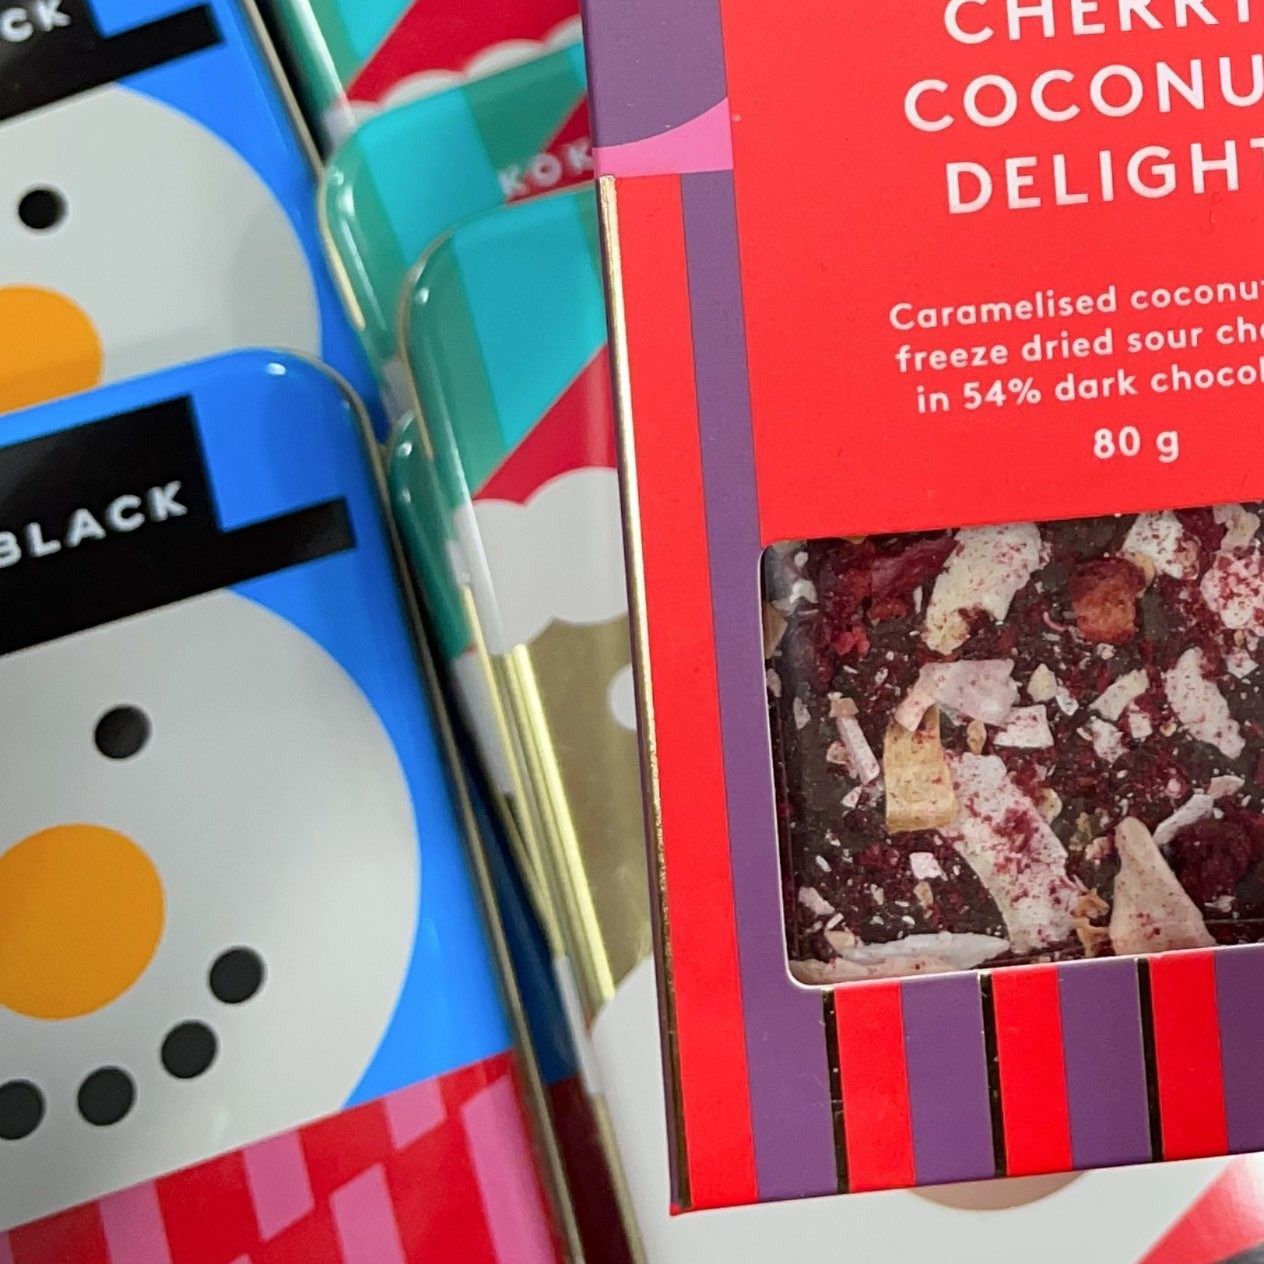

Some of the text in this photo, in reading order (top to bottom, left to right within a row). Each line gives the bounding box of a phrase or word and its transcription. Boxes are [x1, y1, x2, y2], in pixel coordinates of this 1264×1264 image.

[888, 285, 1118, 331] Caramelised
[895, 344, 1009, 373] freeze
[1021, 327, 1114, 362] dried
[1126, 327, 1204, 354] sour
[916, 385, 949, 414] in
[963, 377, 1043, 410] 54%
[1055, 368, 1138, 401] dark
[1093, 425, 1180, 464] 80 g
[0, 479, 188, 569] BLACK
